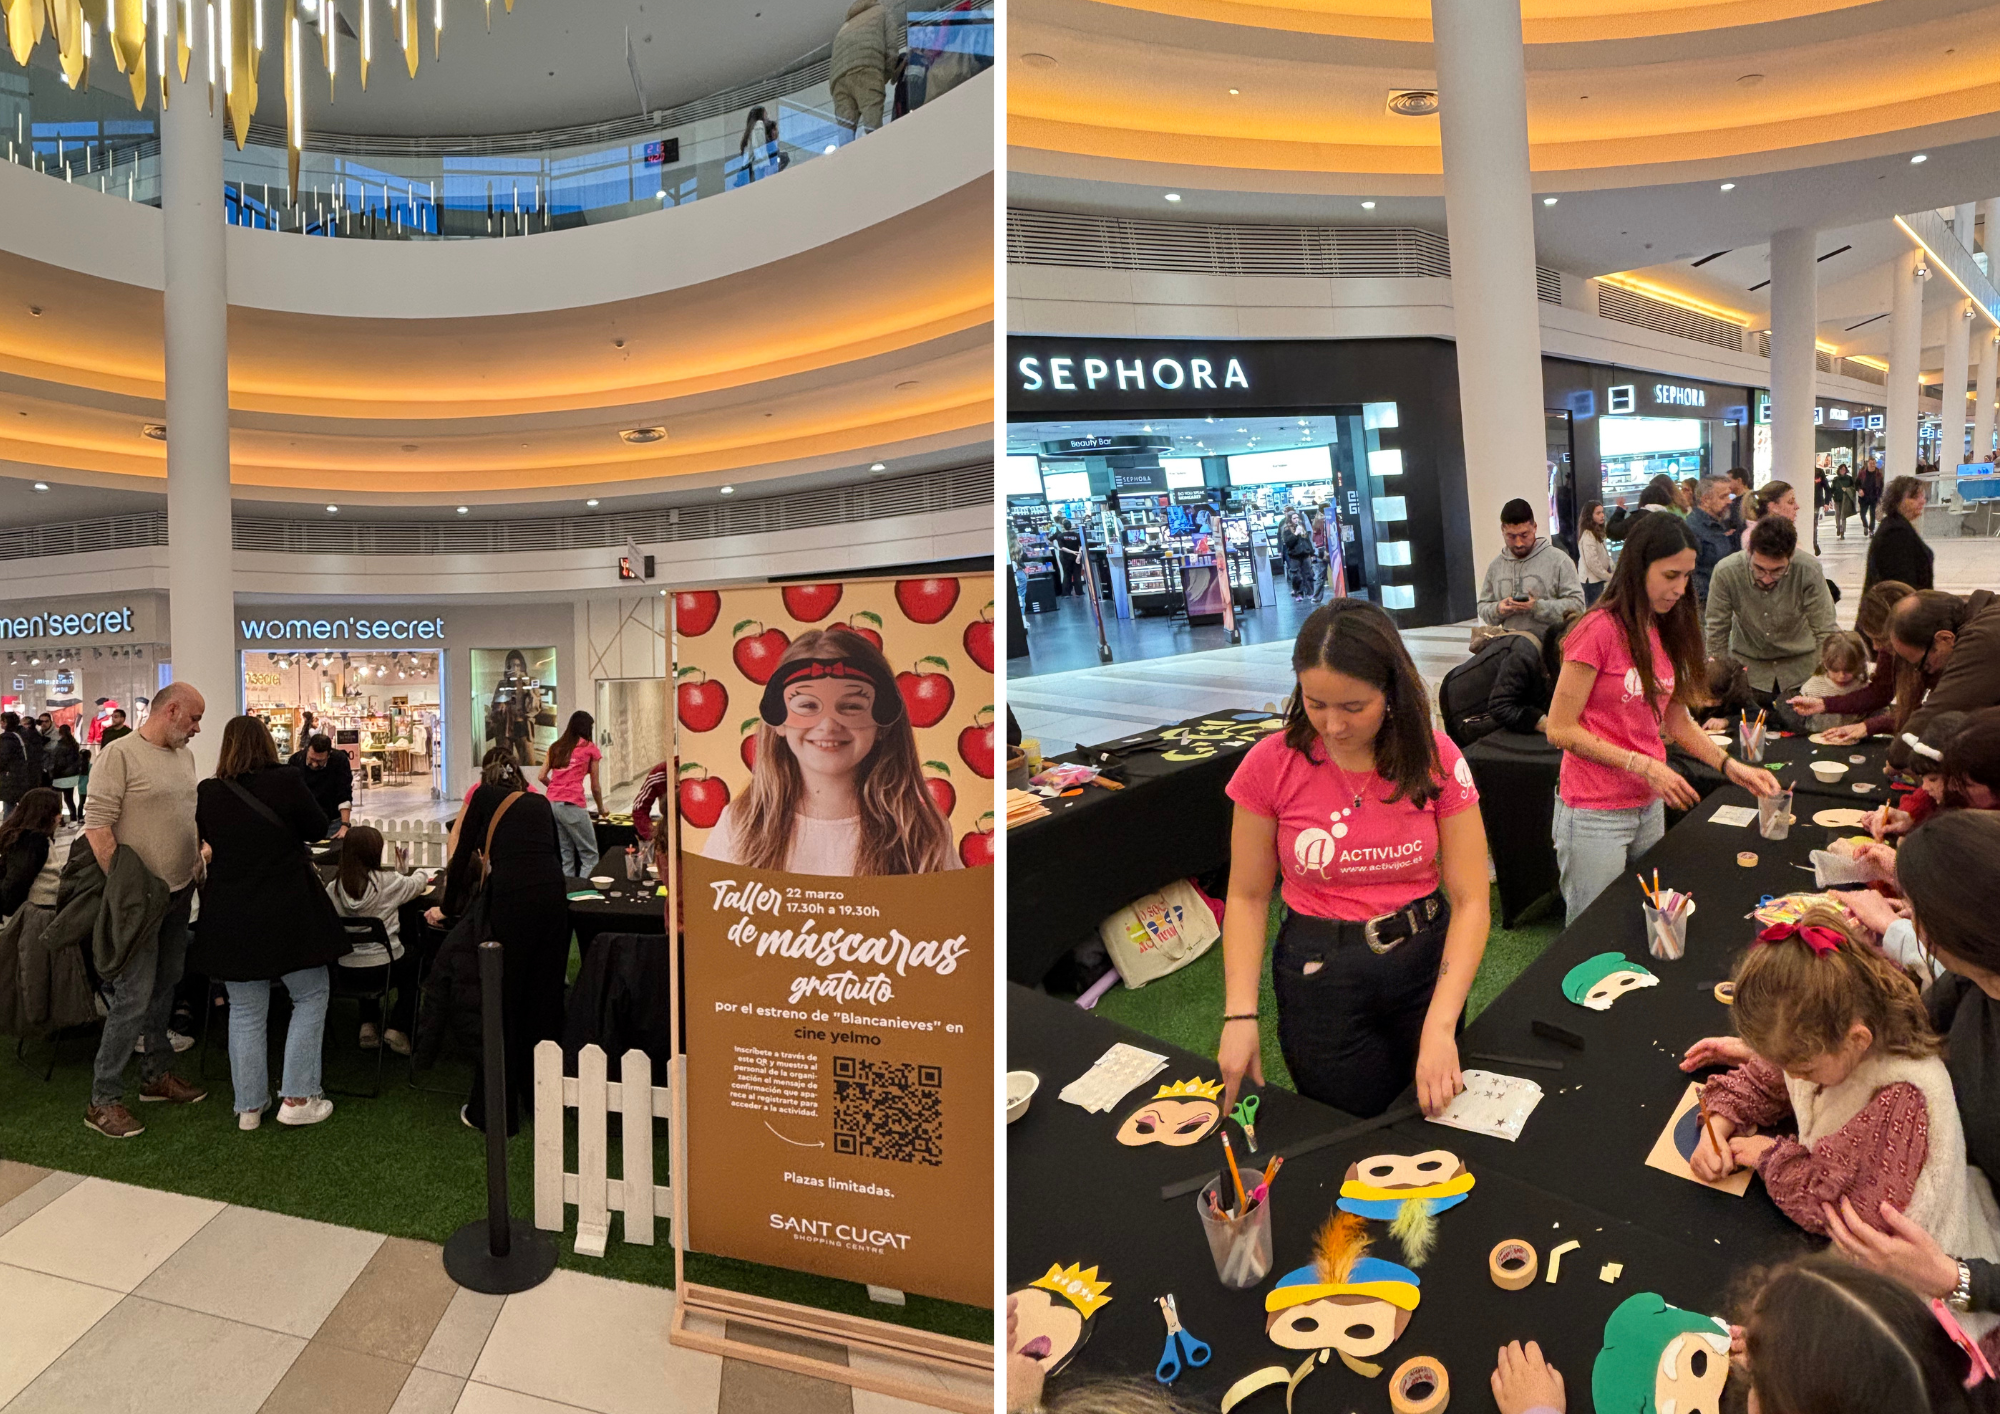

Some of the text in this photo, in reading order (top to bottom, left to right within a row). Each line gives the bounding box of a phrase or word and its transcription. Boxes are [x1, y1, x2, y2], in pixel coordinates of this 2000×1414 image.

[1019, 357, 1249, 390] SEPHORA
[1655, 384, 1706, 407] SEPHORA
[1070, 438, 1112, 448] Beauty Bar
[241, 617, 445, 640] women'secret
[1340, 840, 1422, 862] ACTIVIJOC
[1340, 856, 1423, 874] www.activijoc.es
[710, 880, 782, 917] Taller
[786, 888, 844, 900] 22 marzo
[786, 903, 880, 918] 17.30h a 19.30h
[728, 916, 970, 976] de máscaras
[788, 970, 895, 1006] gratuito
[715, 1001, 964, 1034] por el estreno de "Blancanieves" en
[794, 1026, 882, 1046] cine yelmo
[738, 1056, 754, 1064] este
[756, 1057, 768, 1066] QR
[776, 1061, 809, 1070] muestra
[781, 1051, 805, 1060] través
[806, 1054, 818, 1062] de
[734, 1065, 767, 1074] personal
[768, 1068, 779, 1076] de
[790, 1072, 818, 1080] organi-
[738, 1074, 762, 1082] zación
[773, 1078, 806, 1089] mensaje
[731, 1082, 782, 1094] confirmación
[730, 1092, 746, 1100] rece
[757, 1094, 798, 1106] registrarte
[800, 1100, 818, 1108] para
[731, 1100, 762, 1110] acceder
[770, 1104, 777, 1112] la
[779, 1107, 818, 1117] actividad.
[784, 1172, 895, 1198] Plazas limitadas.
[770, 1214, 911, 1250] SANT CUGAT
[794, 1233, 885, 1255] SHOPPING CENTRE
